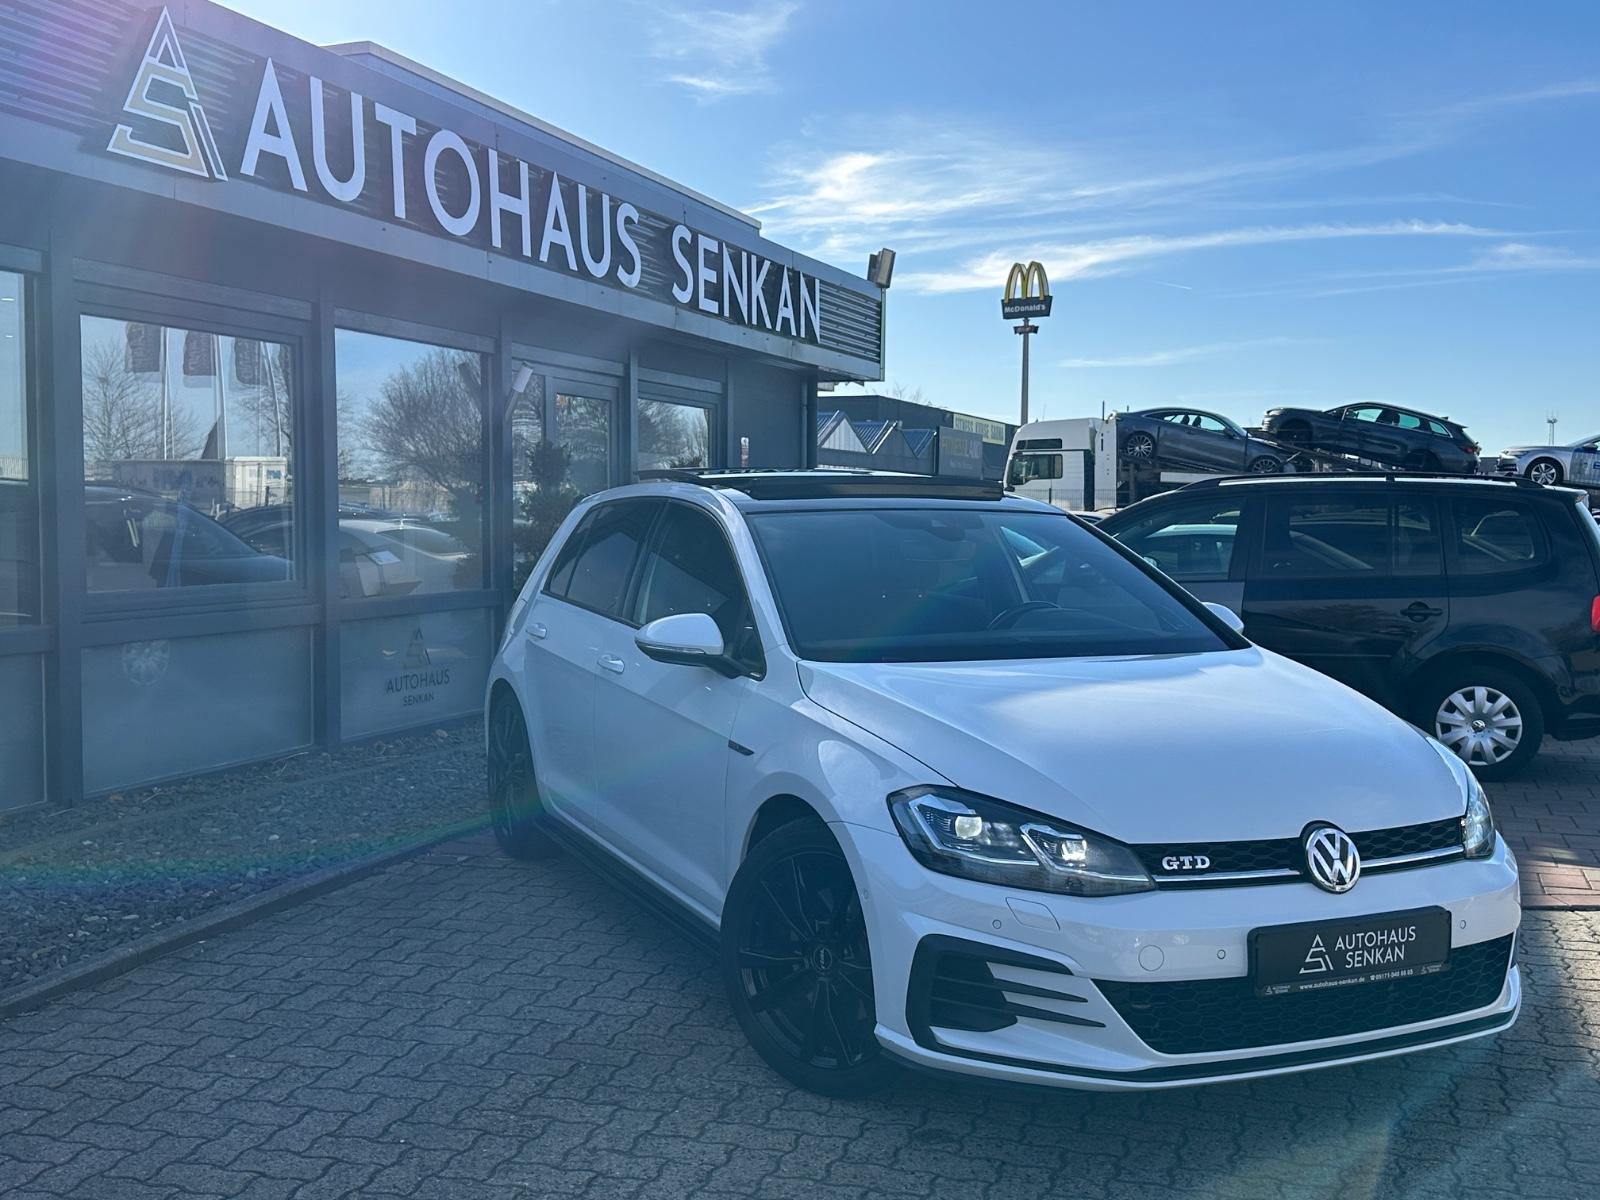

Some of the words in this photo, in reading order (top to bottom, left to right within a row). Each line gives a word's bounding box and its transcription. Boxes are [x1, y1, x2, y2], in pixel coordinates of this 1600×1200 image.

[240, 57, 642, 289] AUTOHAUS
[671, 224, 821, 343] SENKAN
[1004, 304, 1046, 313] McDonald's
[385, 669, 450, 694] AUTOHAUS
[403, 692, 434, 706] SENKAN
[1162, 855, 1211, 870] GTD
[1335, 926, 1416, 951] AUTOHAUS
[1345, 944, 1405, 968] SENKAN
